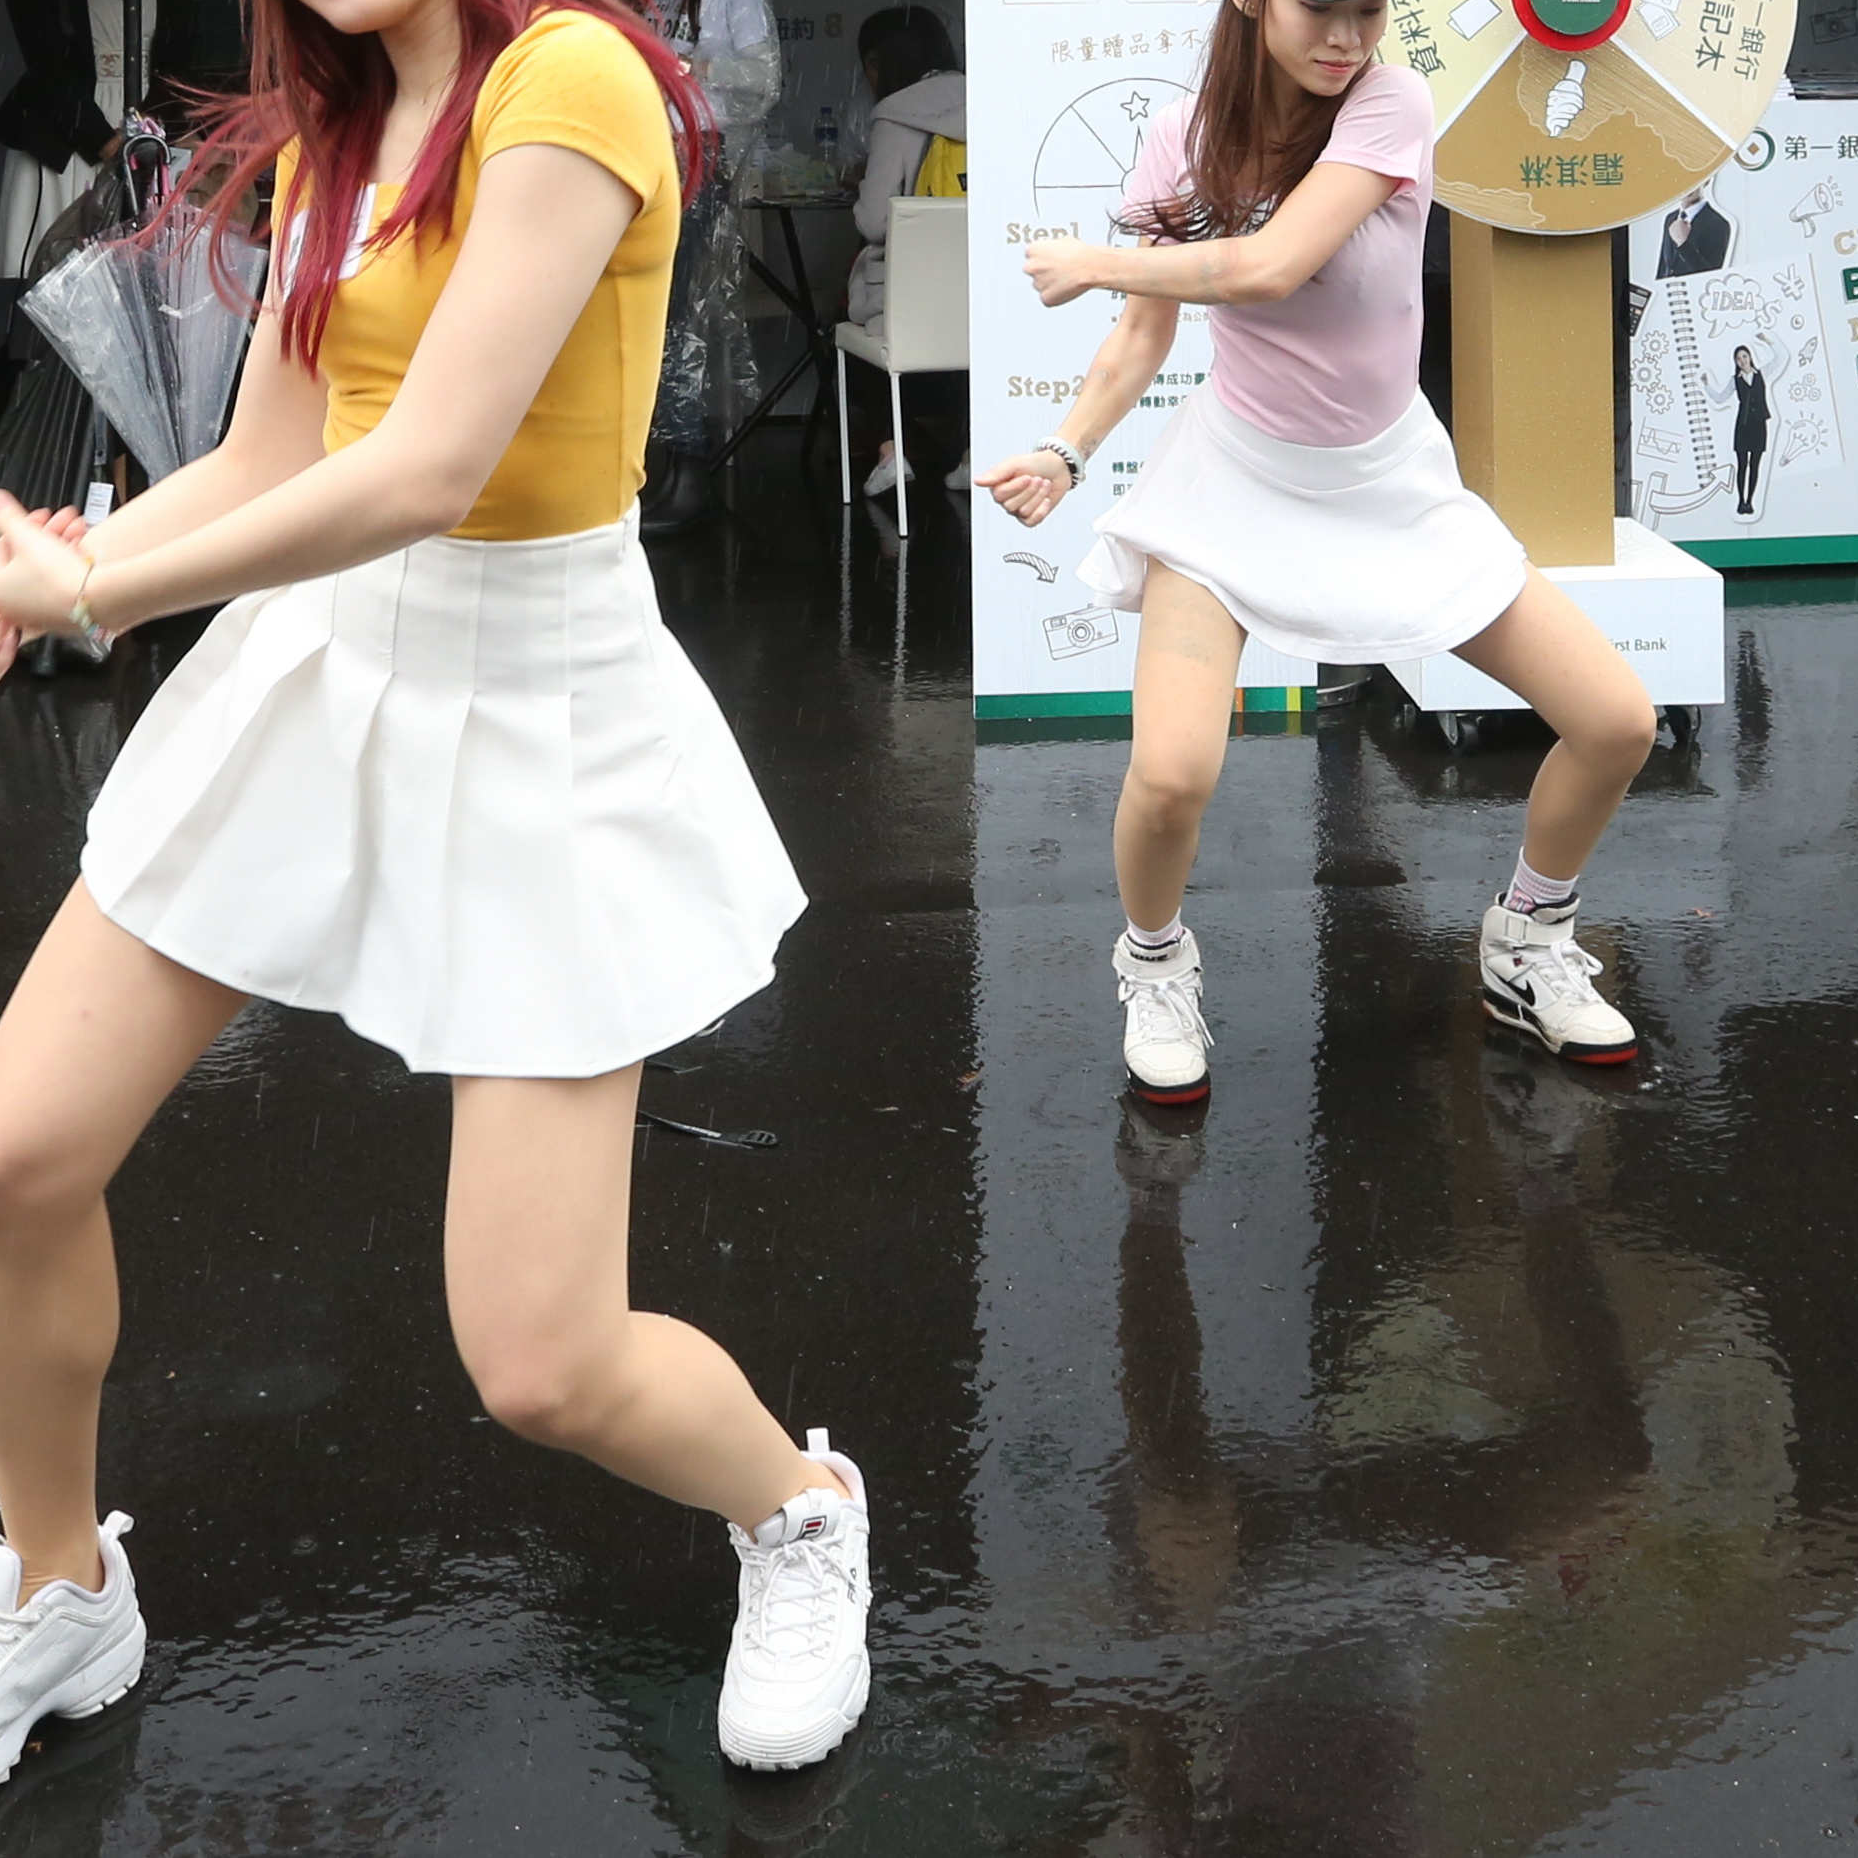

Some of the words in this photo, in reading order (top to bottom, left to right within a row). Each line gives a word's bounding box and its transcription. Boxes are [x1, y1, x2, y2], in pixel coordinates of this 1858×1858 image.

[1518, 152, 1625, 189] 霜淇淋
[1634, 636, 1668, 652] Bank
